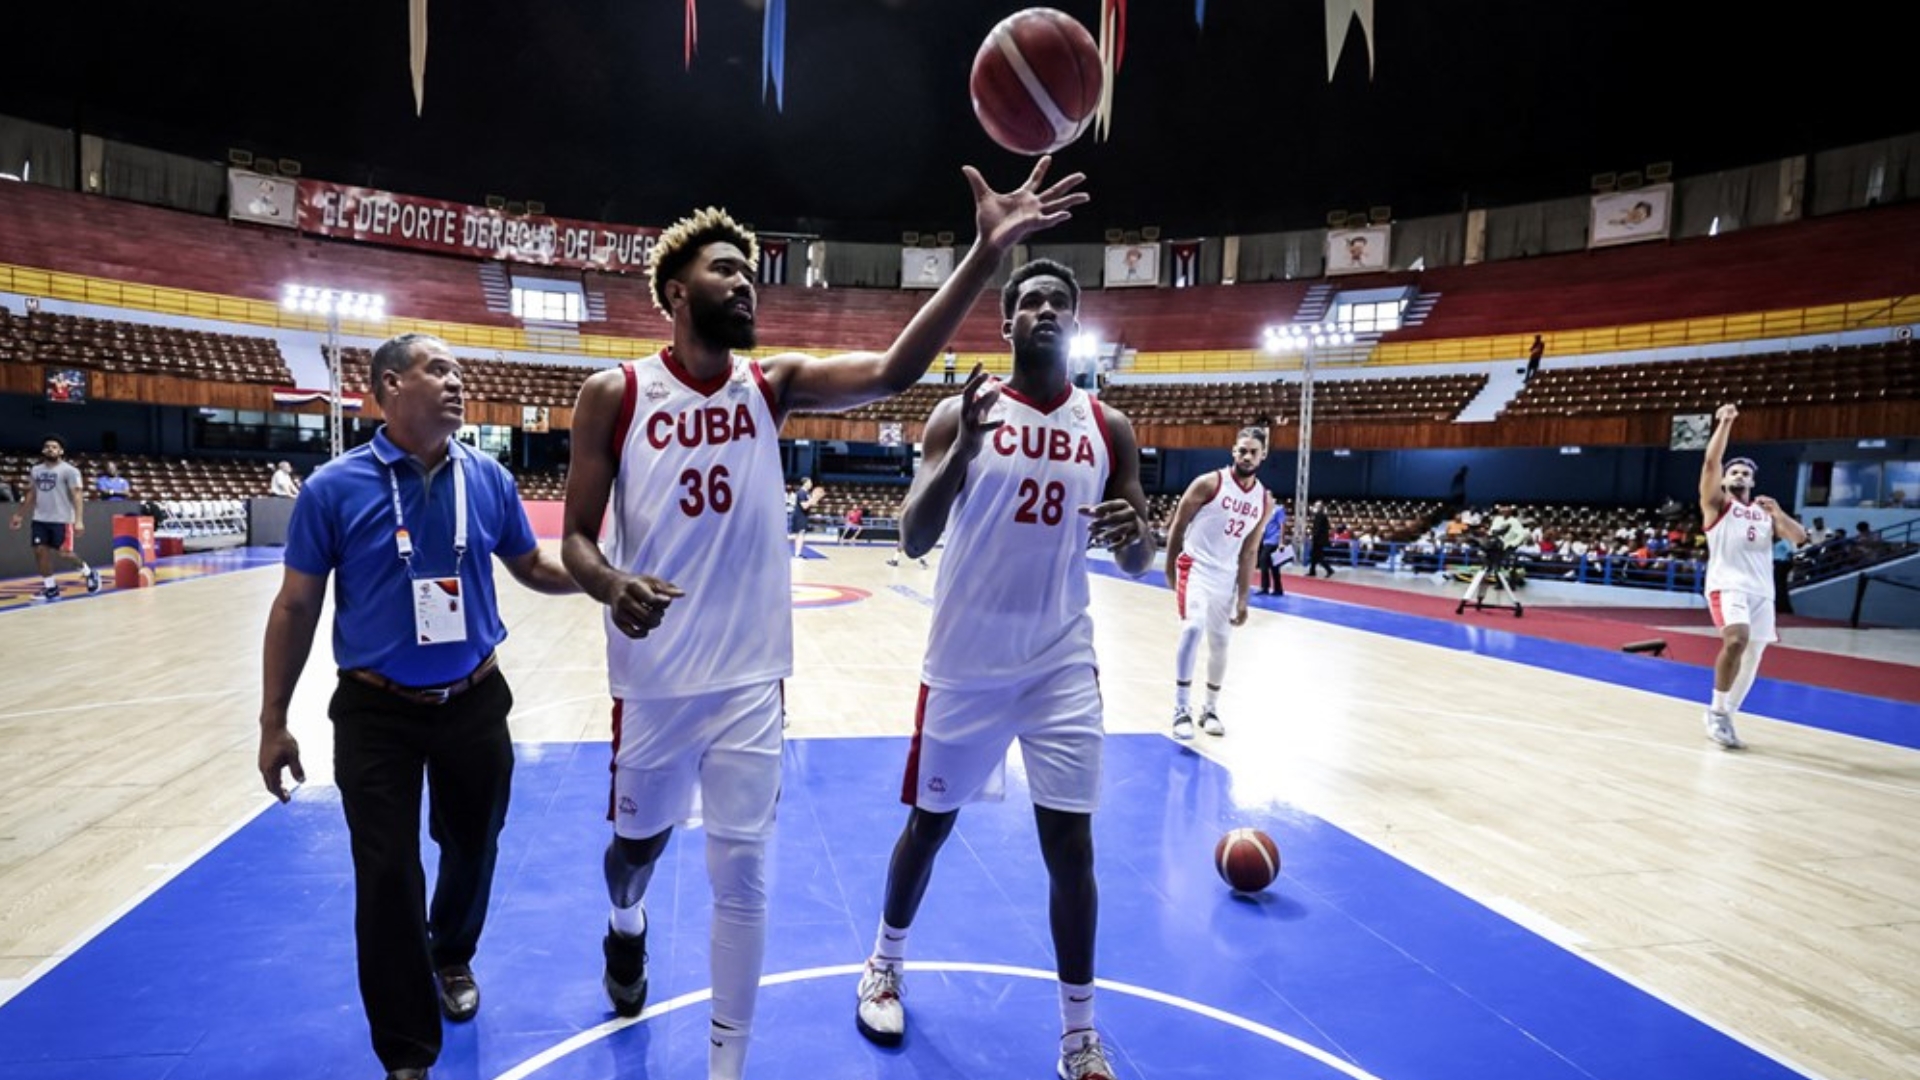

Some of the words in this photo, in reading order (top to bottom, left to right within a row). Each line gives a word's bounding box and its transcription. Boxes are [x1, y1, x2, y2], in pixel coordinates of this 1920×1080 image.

[355, 196, 457, 244] DEPORTE
[564, 229, 599, 261] DEL
[647, 404, 756, 450] CUBA
[993, 425, 1095, 468] CUBA
[680, 464, 733, 517] 36
[1014, 477, 1066, 526] 28
[1222, 496, 1259, 519] CUBA
[1224, 518, 1245, 537] 32
[1747, 525, 1756, 542] 6
